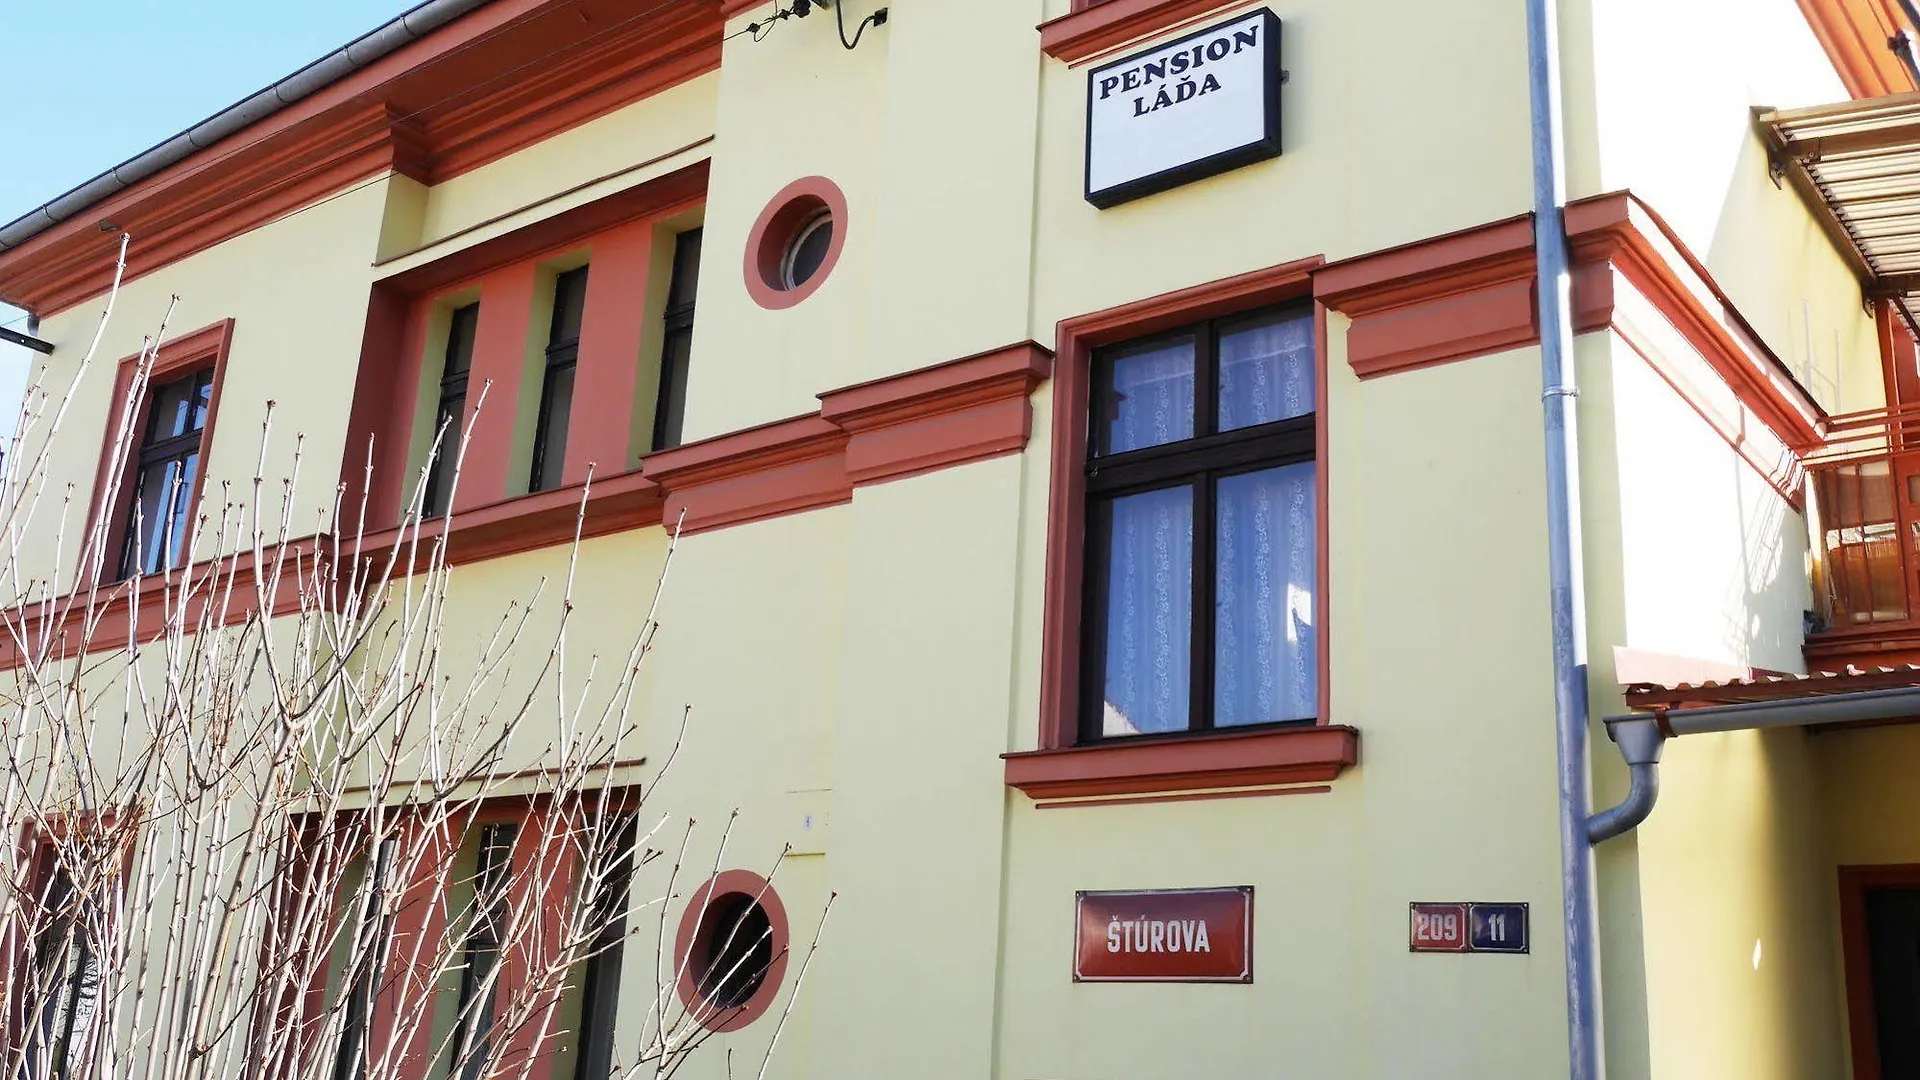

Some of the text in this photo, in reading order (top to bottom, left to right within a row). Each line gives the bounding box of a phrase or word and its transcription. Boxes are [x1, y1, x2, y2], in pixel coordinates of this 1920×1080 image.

[1099, 25, 1259, 100] PENSION
[1133, 73, 1222, 117] LÁĎA
[1107, 914, 1211, 953] ŠTÚROVA
[1417, 913, 1457, 941] 209
[1488, 913, 1505, 941] 11
